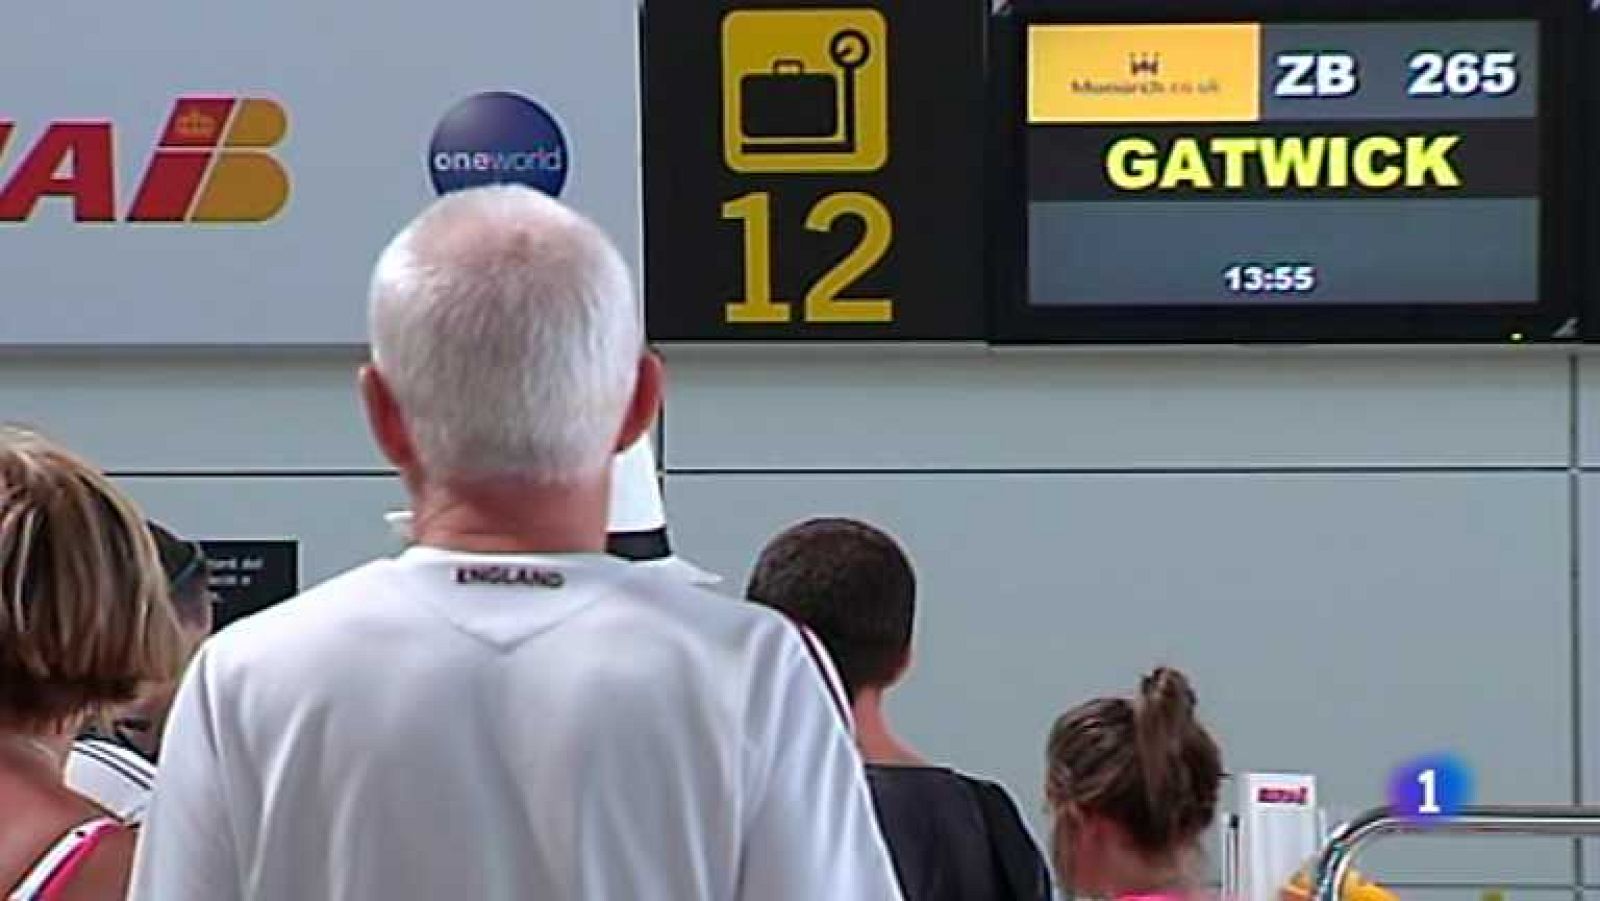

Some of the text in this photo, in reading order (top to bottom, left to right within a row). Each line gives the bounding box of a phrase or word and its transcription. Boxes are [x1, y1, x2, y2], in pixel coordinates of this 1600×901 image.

[1275, 52, 1517, 97] ZB 265
[0, 123, 116, 221] A
[434, 146, 562, 171] oneworld
[1107, 136, 1460, 190] GATWICK
[722, 191, 893, 323] 12
[1225, 266, 1315, 291] 13:55
[456, 566, 564, 590] ENGLAND
